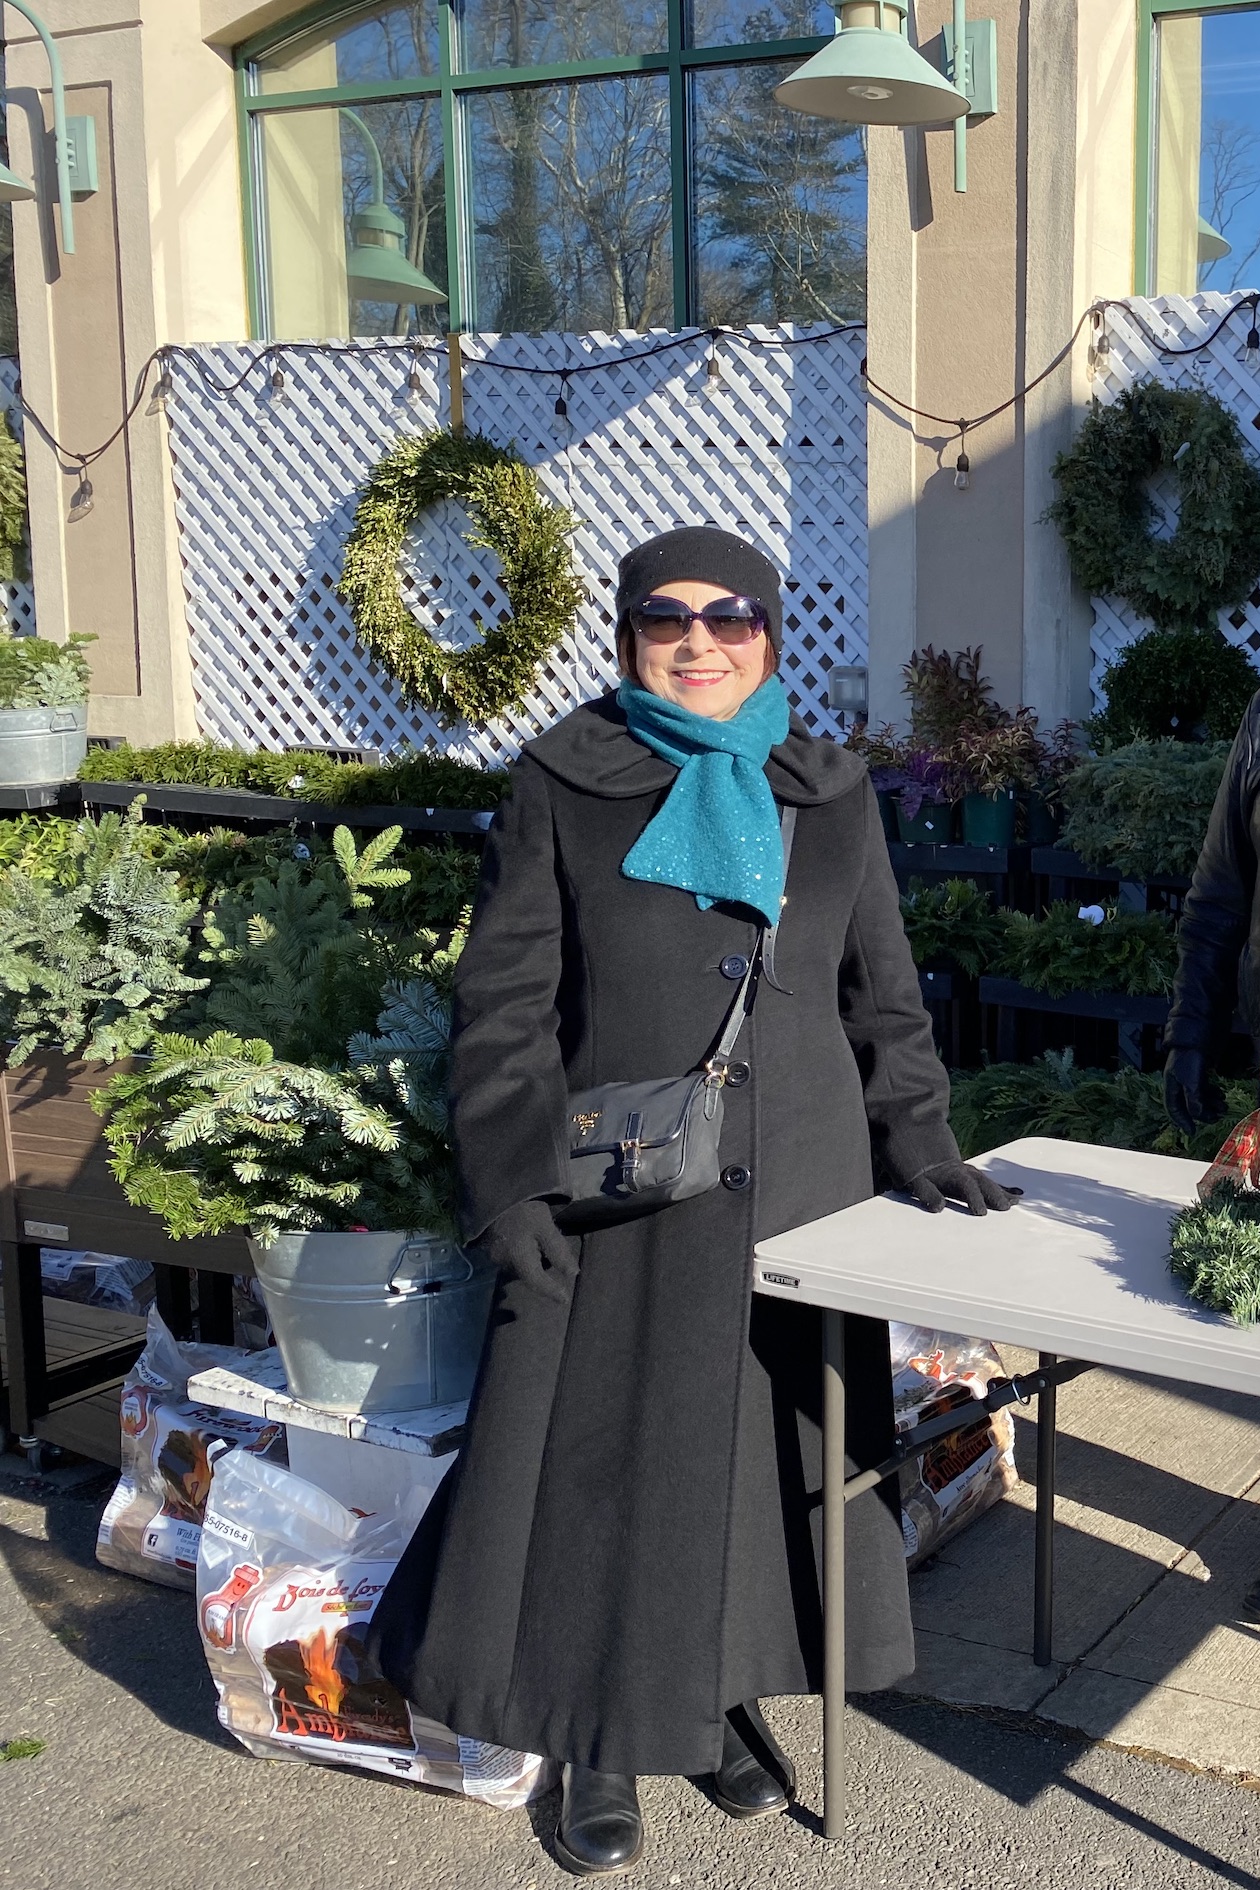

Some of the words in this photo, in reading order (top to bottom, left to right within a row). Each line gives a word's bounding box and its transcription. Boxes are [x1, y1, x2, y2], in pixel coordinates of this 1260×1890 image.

[272, 1580, 324, 1612] Bois
[326, 1579, 349, 1597] de
[343, 1577, 386, 1610] foy
